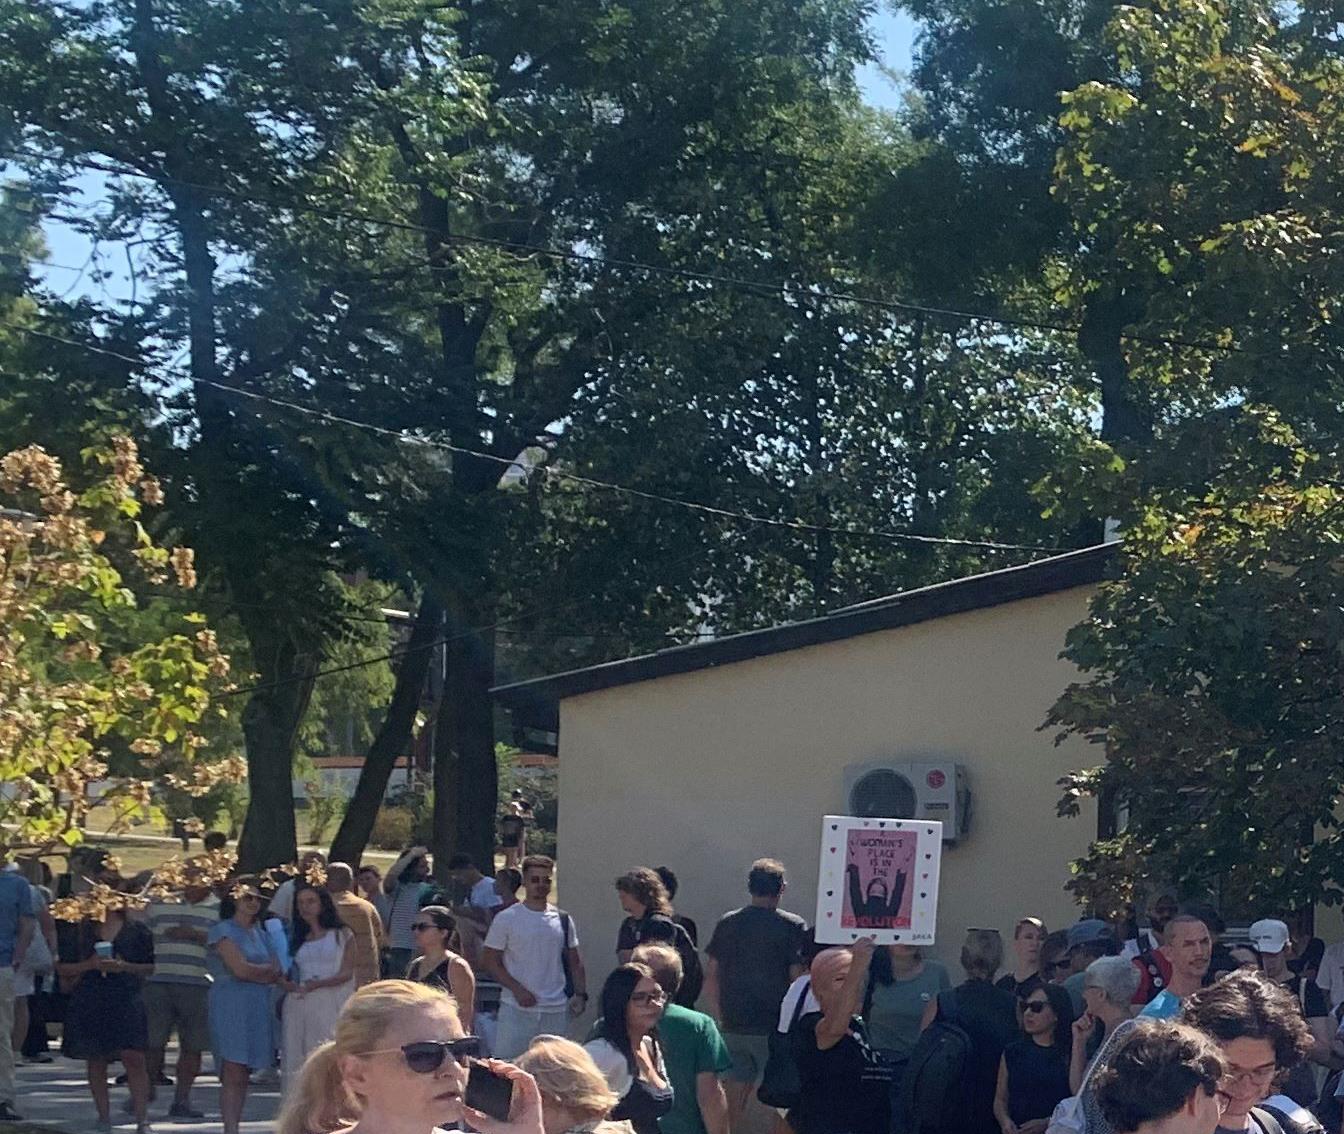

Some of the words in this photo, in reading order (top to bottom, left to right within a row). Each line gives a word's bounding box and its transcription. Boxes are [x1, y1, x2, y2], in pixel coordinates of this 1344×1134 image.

[860, 839, 903, 848] WOMAN'S
[868, 848, 895, 858] PLACE
[874, 867, 888, 877] THE
